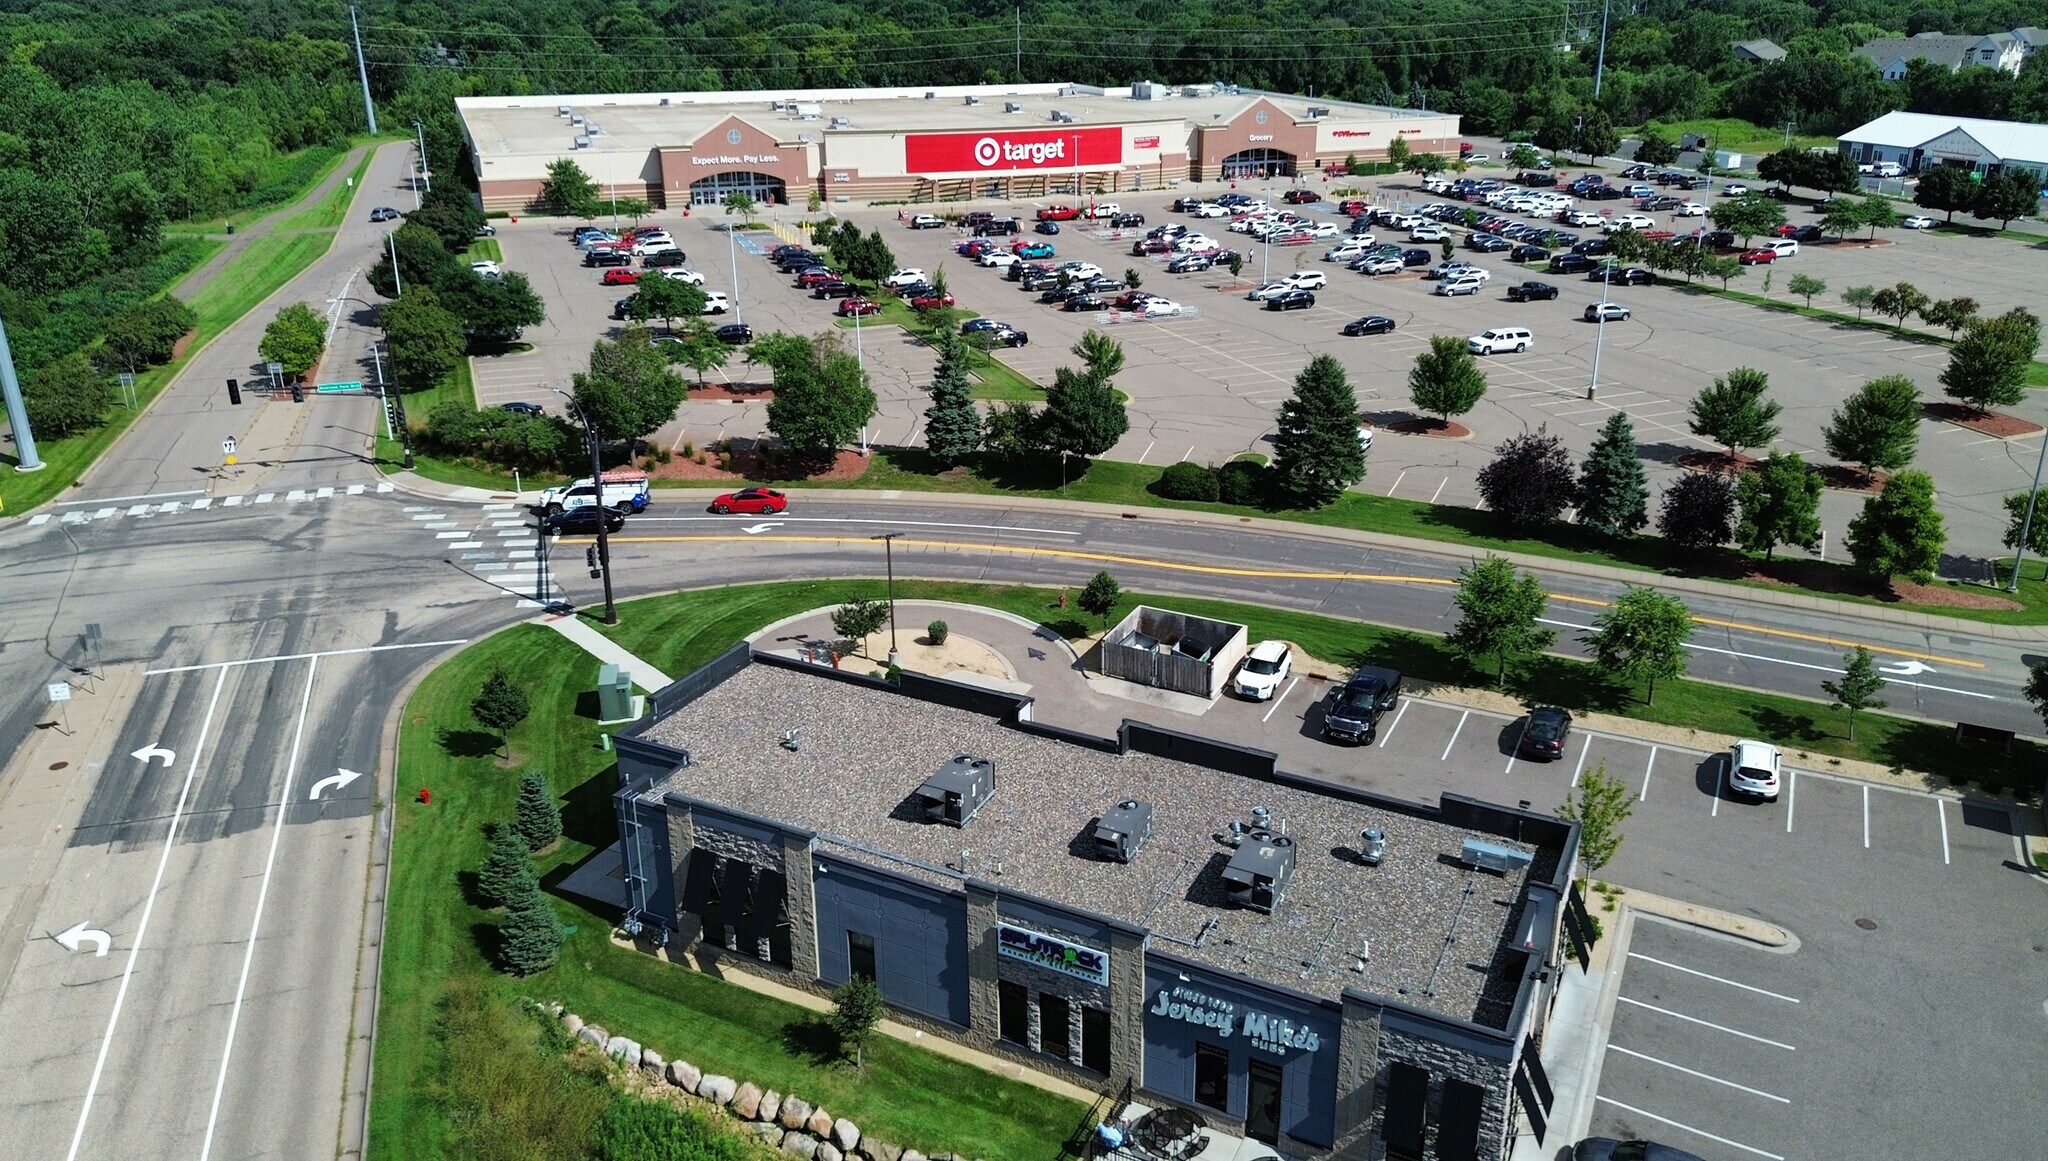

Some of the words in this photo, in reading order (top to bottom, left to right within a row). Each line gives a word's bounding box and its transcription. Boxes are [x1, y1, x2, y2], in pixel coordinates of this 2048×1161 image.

[1249, 134, 1274, 142] Grocery
[692, 156, 719, 166] Expect
[720, 155, 742, 164] More.
[743, 154, 758, 164] Pay
[759, 154, 779, 163] Less.
[1003, 138, 1065, 164] target
[1151, 990, 1234, 1038] Jersey
[1242, 1011, 1321, 1052] Mike's
[1251, 1037, 1286, 1056] SUBS
